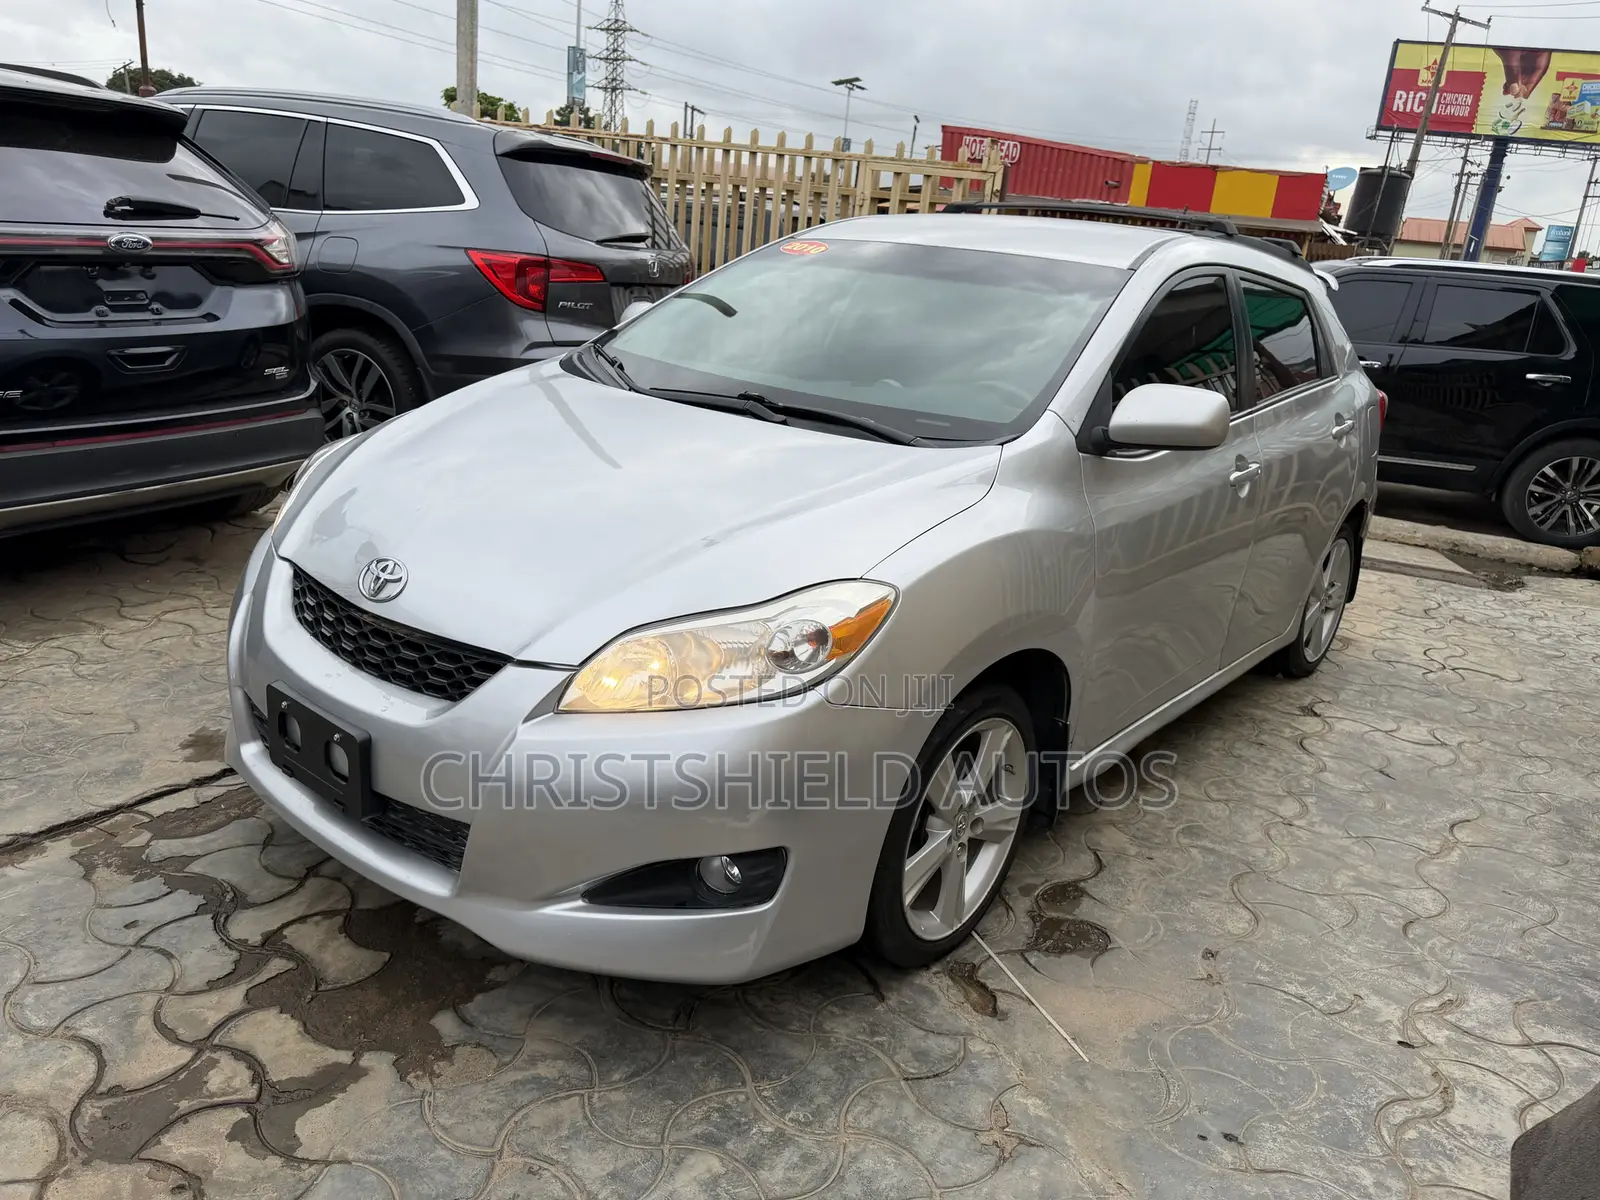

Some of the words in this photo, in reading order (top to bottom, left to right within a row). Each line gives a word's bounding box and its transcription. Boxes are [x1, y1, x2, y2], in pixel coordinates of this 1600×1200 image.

[1440, 92, 1473, 106] CHICKEN
[1437, 104, 1470, 117] FLAVOUR
[121, 237, 144, 249] Ford
[783, 242, 827, 254] 2010
[557, 301, 594, 310] PILOT
